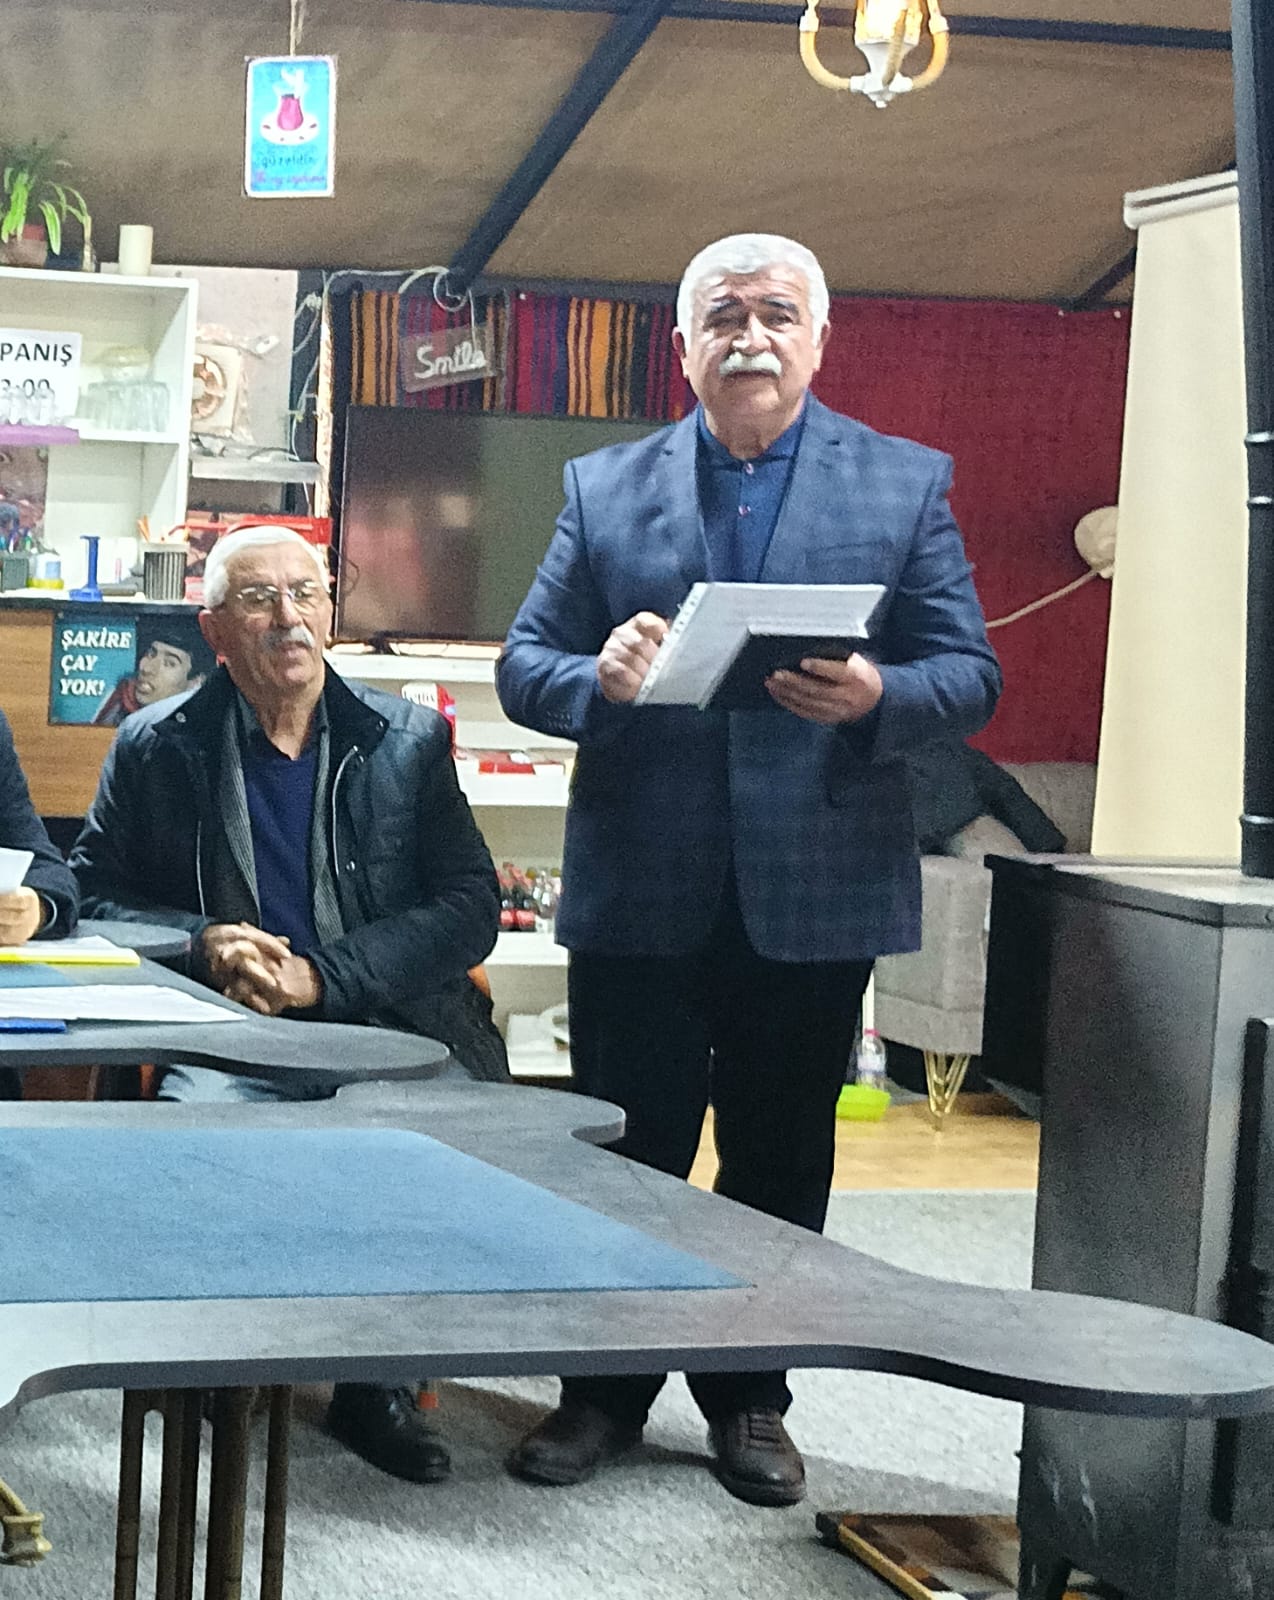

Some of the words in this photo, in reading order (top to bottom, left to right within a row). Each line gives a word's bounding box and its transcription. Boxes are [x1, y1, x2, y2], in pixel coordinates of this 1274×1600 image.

[0, 342, 73, 368] PANIŞ
[61, 627, 132, 652] ŞAKİRE
[61, 654, 98, 676] ÇAY
[60, 678, 106, 696] YOK!
